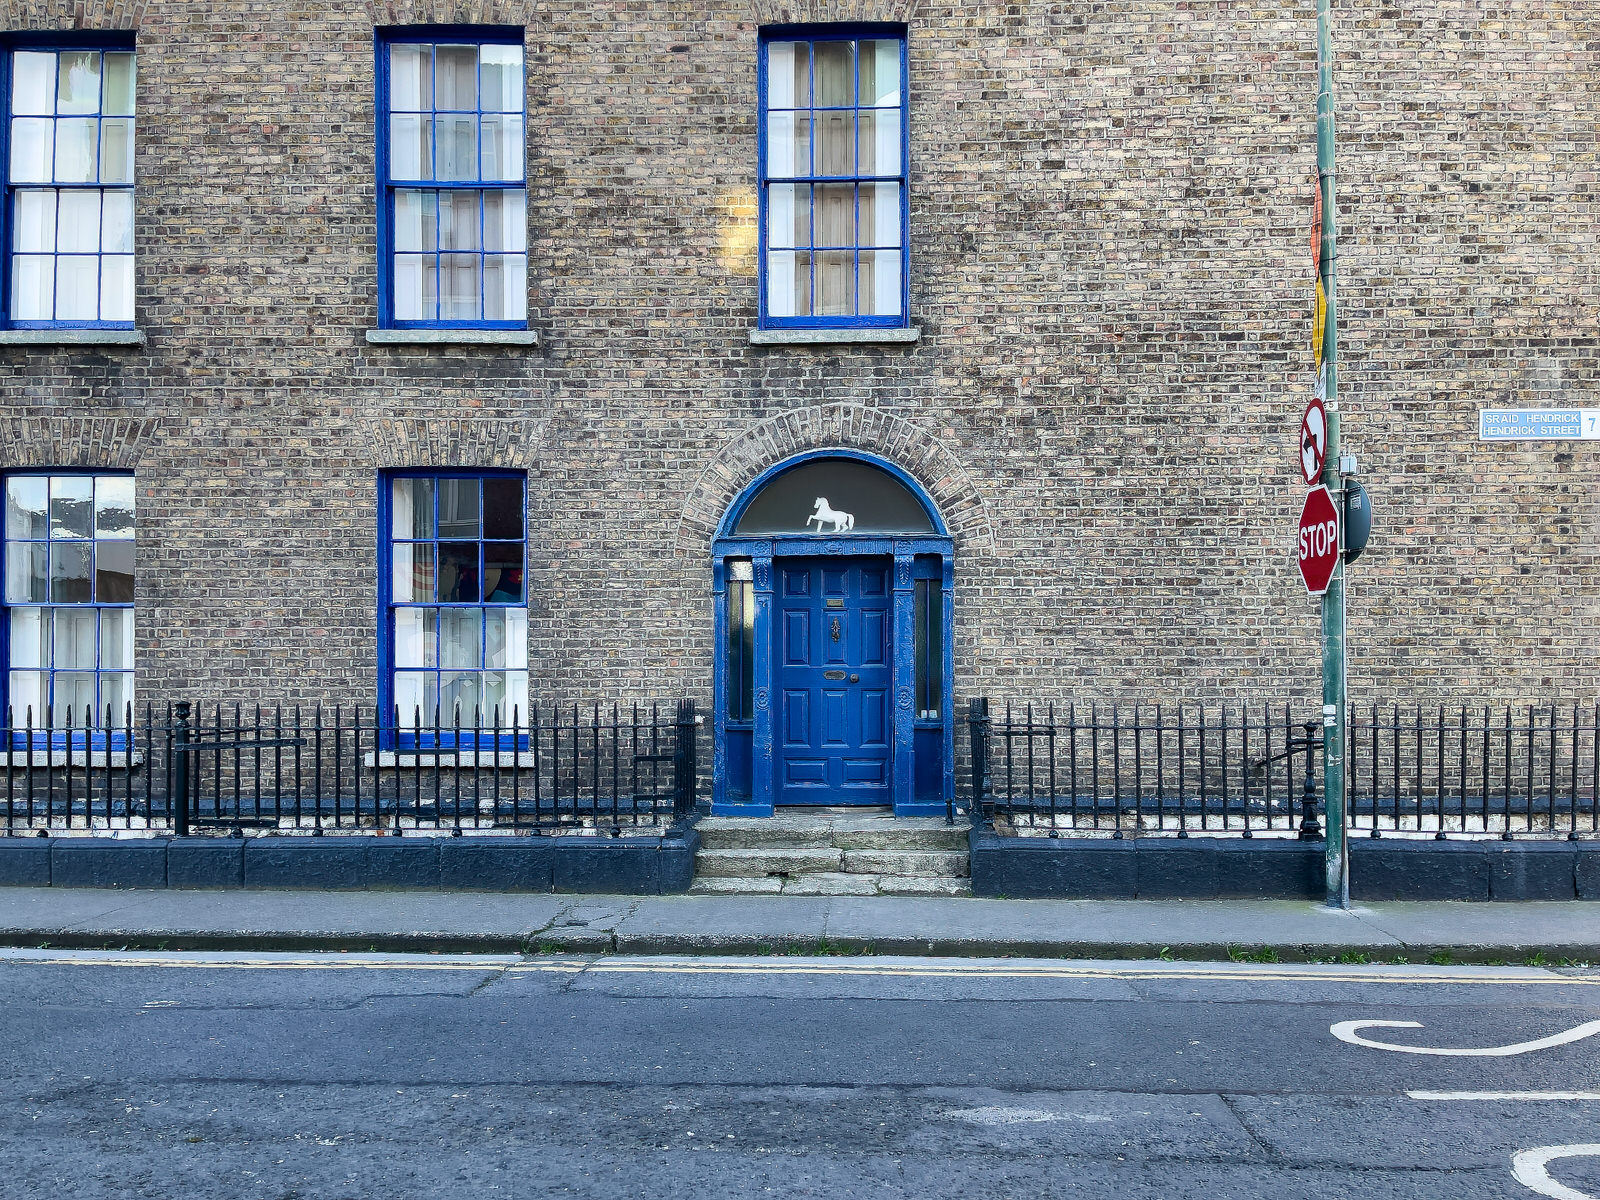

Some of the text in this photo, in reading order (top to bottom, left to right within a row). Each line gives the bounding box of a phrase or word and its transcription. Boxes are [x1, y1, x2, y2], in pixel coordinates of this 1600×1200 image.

[1526, 414, 1579, 423] HENDRICK
[1588, 417, 1597, 432] 7
[1483, 425, 1580, 436] HENDRICK STREET
[1300, 520, 1336, 560] STOP
